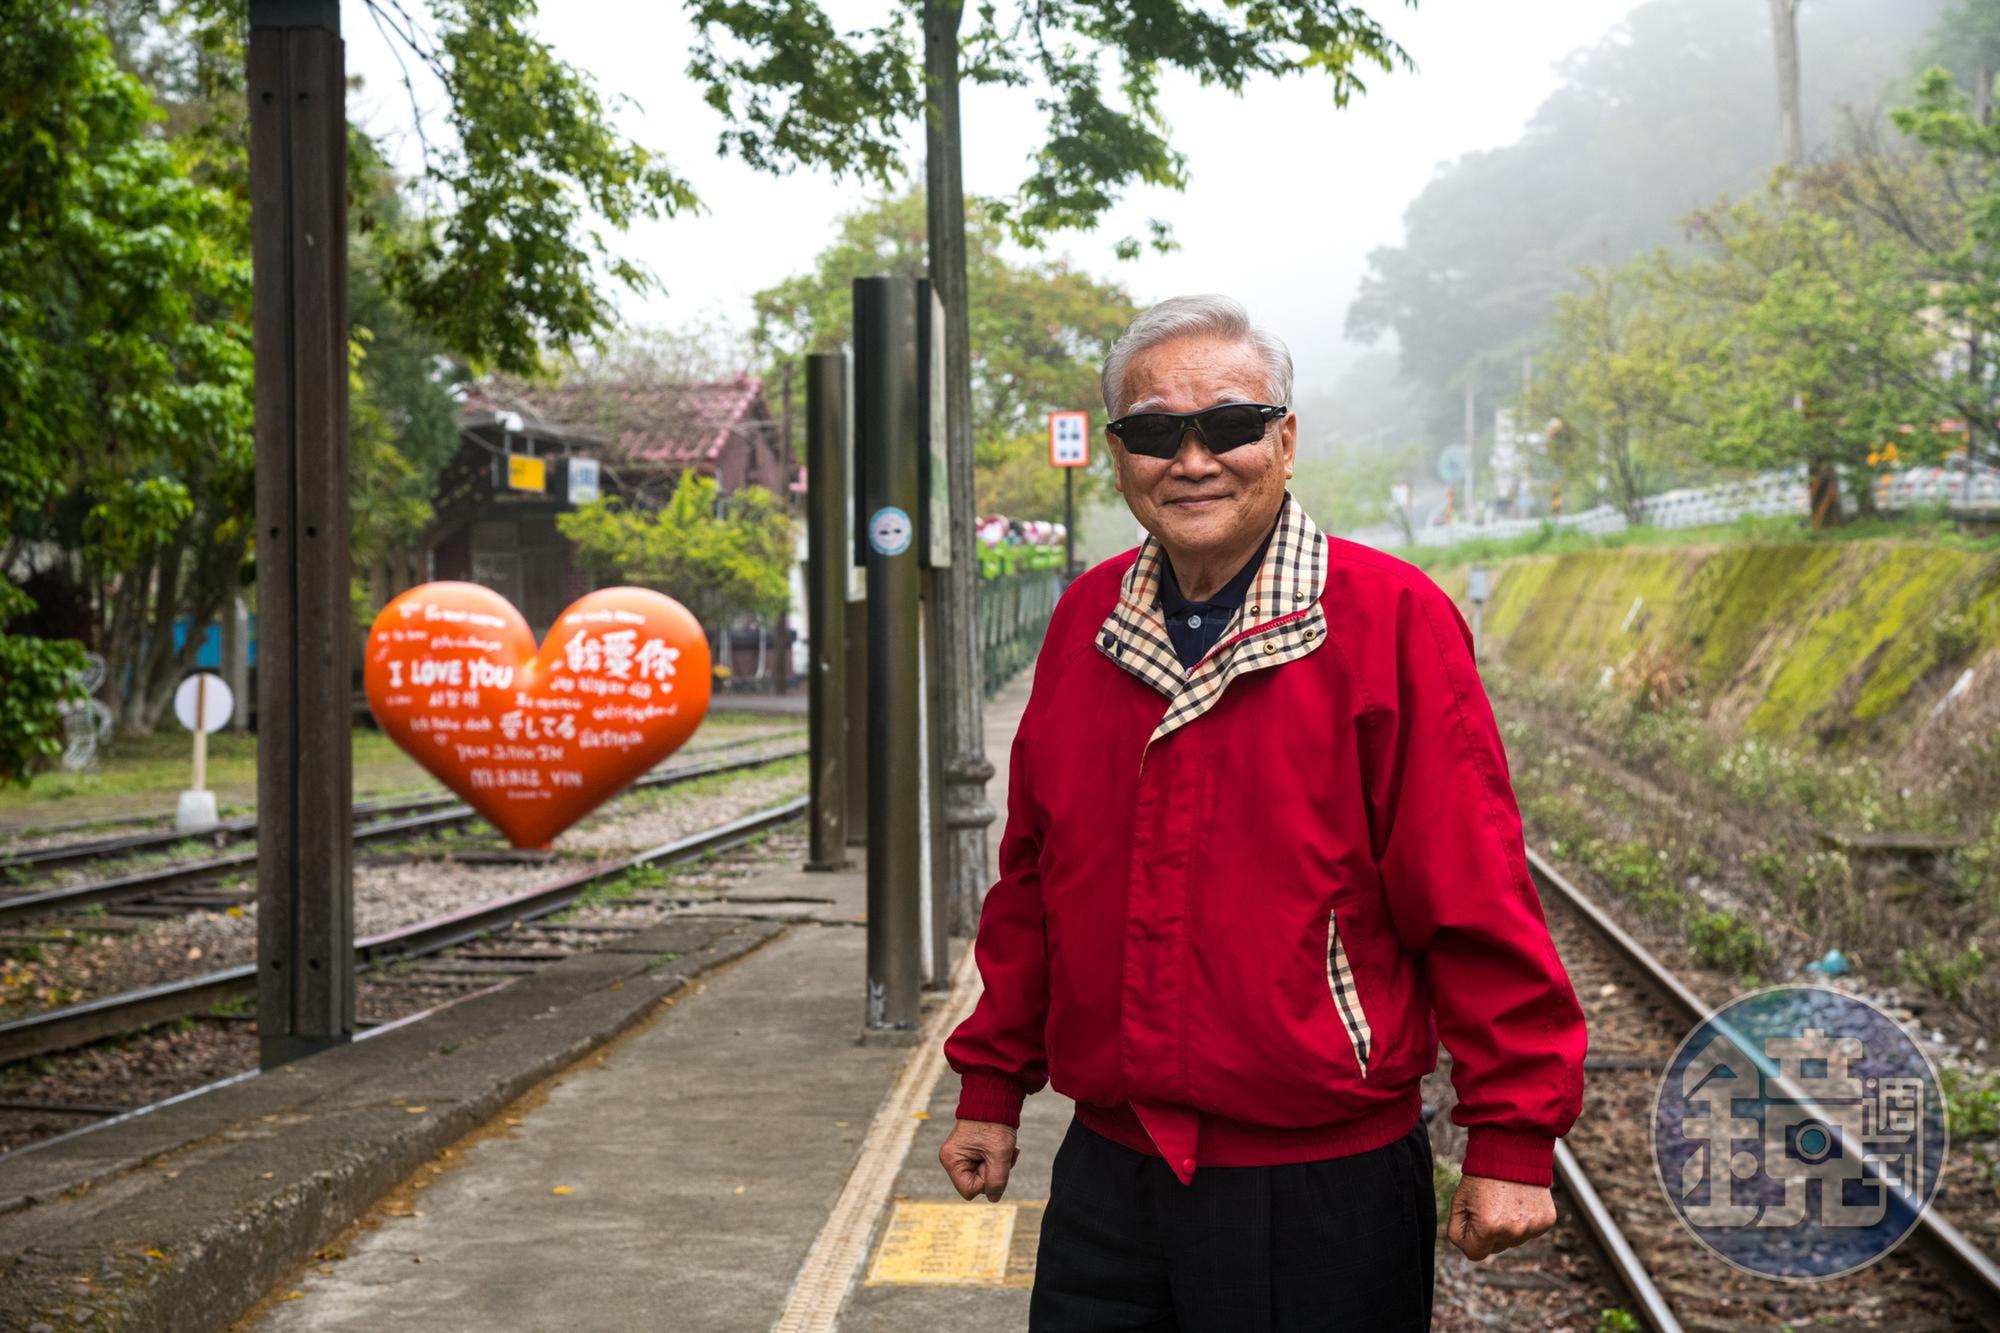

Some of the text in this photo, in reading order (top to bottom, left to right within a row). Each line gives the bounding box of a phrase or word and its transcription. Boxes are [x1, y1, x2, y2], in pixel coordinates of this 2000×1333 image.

[564, 628, 680, 681] 我愛你
[389, 656, 514, 690] I LOVE YOU
[500, 709, 577, 740] 愛してる
